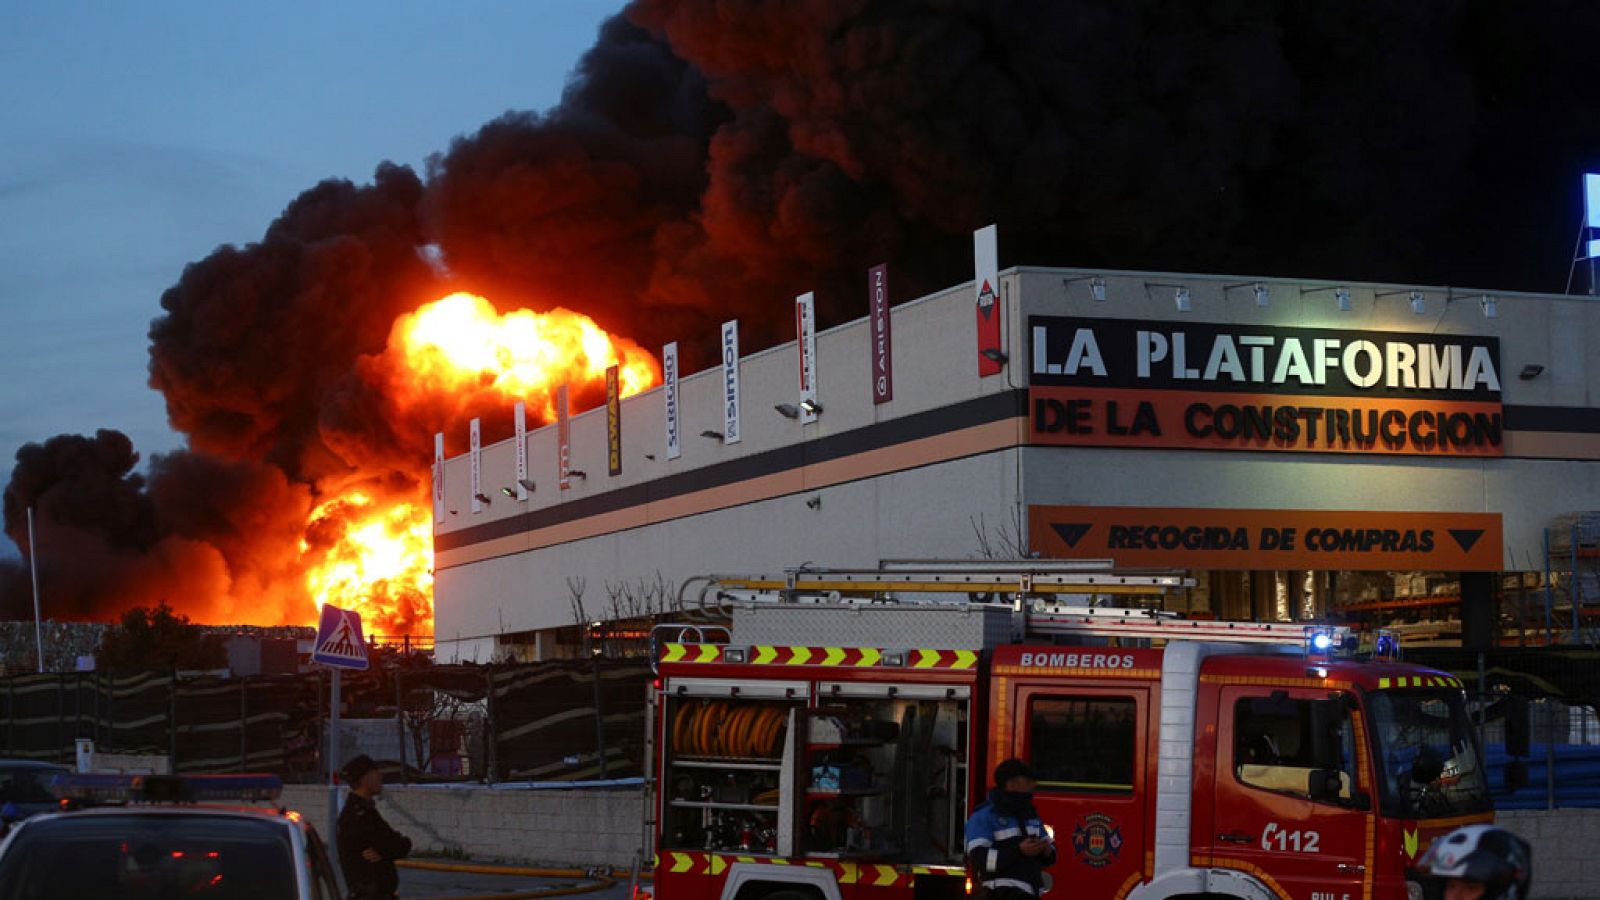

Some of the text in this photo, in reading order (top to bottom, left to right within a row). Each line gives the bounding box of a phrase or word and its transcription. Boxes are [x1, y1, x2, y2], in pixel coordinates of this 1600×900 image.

[875, 271, 886, 374] ARISTON
[1033, 326, 1501, 391] LA PLATAFORMA
[665, 354, 677, 447] SCRIGNO
[1035, 398, 1501, 448] DE LA CONSTRUCCION
[1108, 526, 1435, 552] RECOGIDA DE COMPRAS
[1021, 652, 1134, 668] BOMBEROS
[1275, 829, 1320, 853] 112
